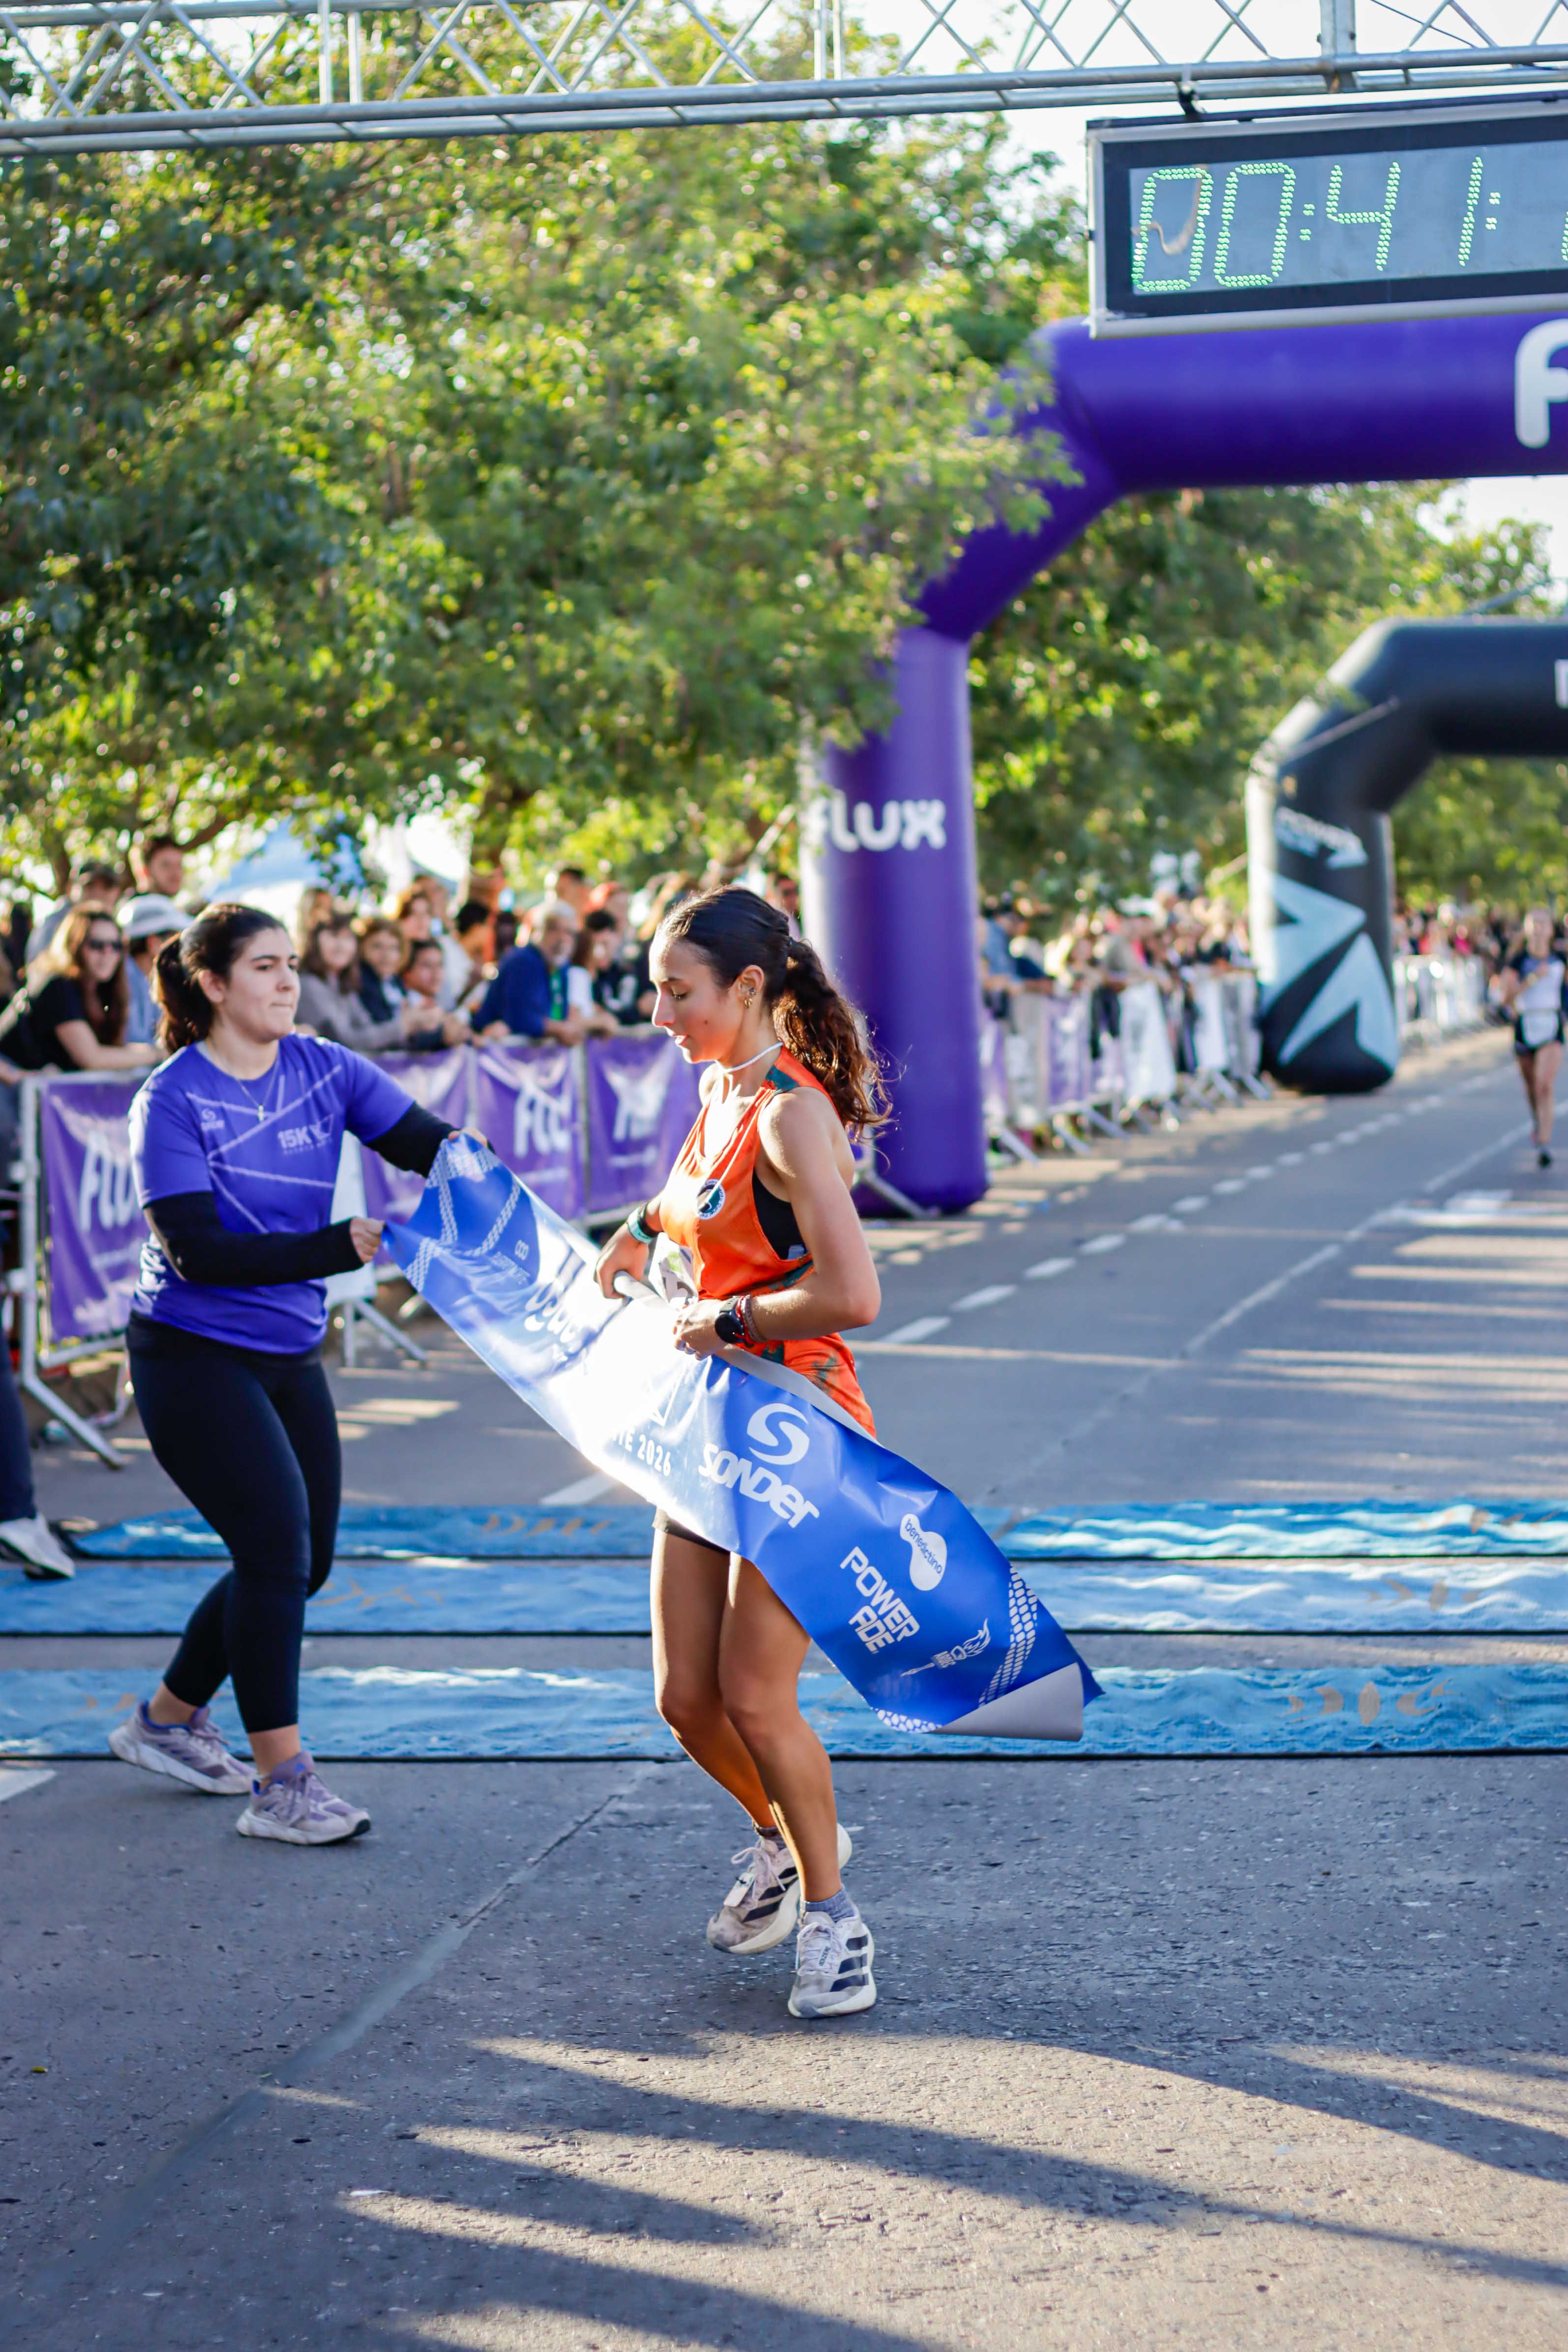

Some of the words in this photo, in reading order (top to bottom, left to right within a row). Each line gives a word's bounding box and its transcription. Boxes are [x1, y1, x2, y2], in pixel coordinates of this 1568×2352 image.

[637, 1435, 671, 1476] 2026
[905, 1519, 943, 1574] benedictino
[839, 1546, 920, 1642] POWER
[848, 1605, 895, 1654] ADE
